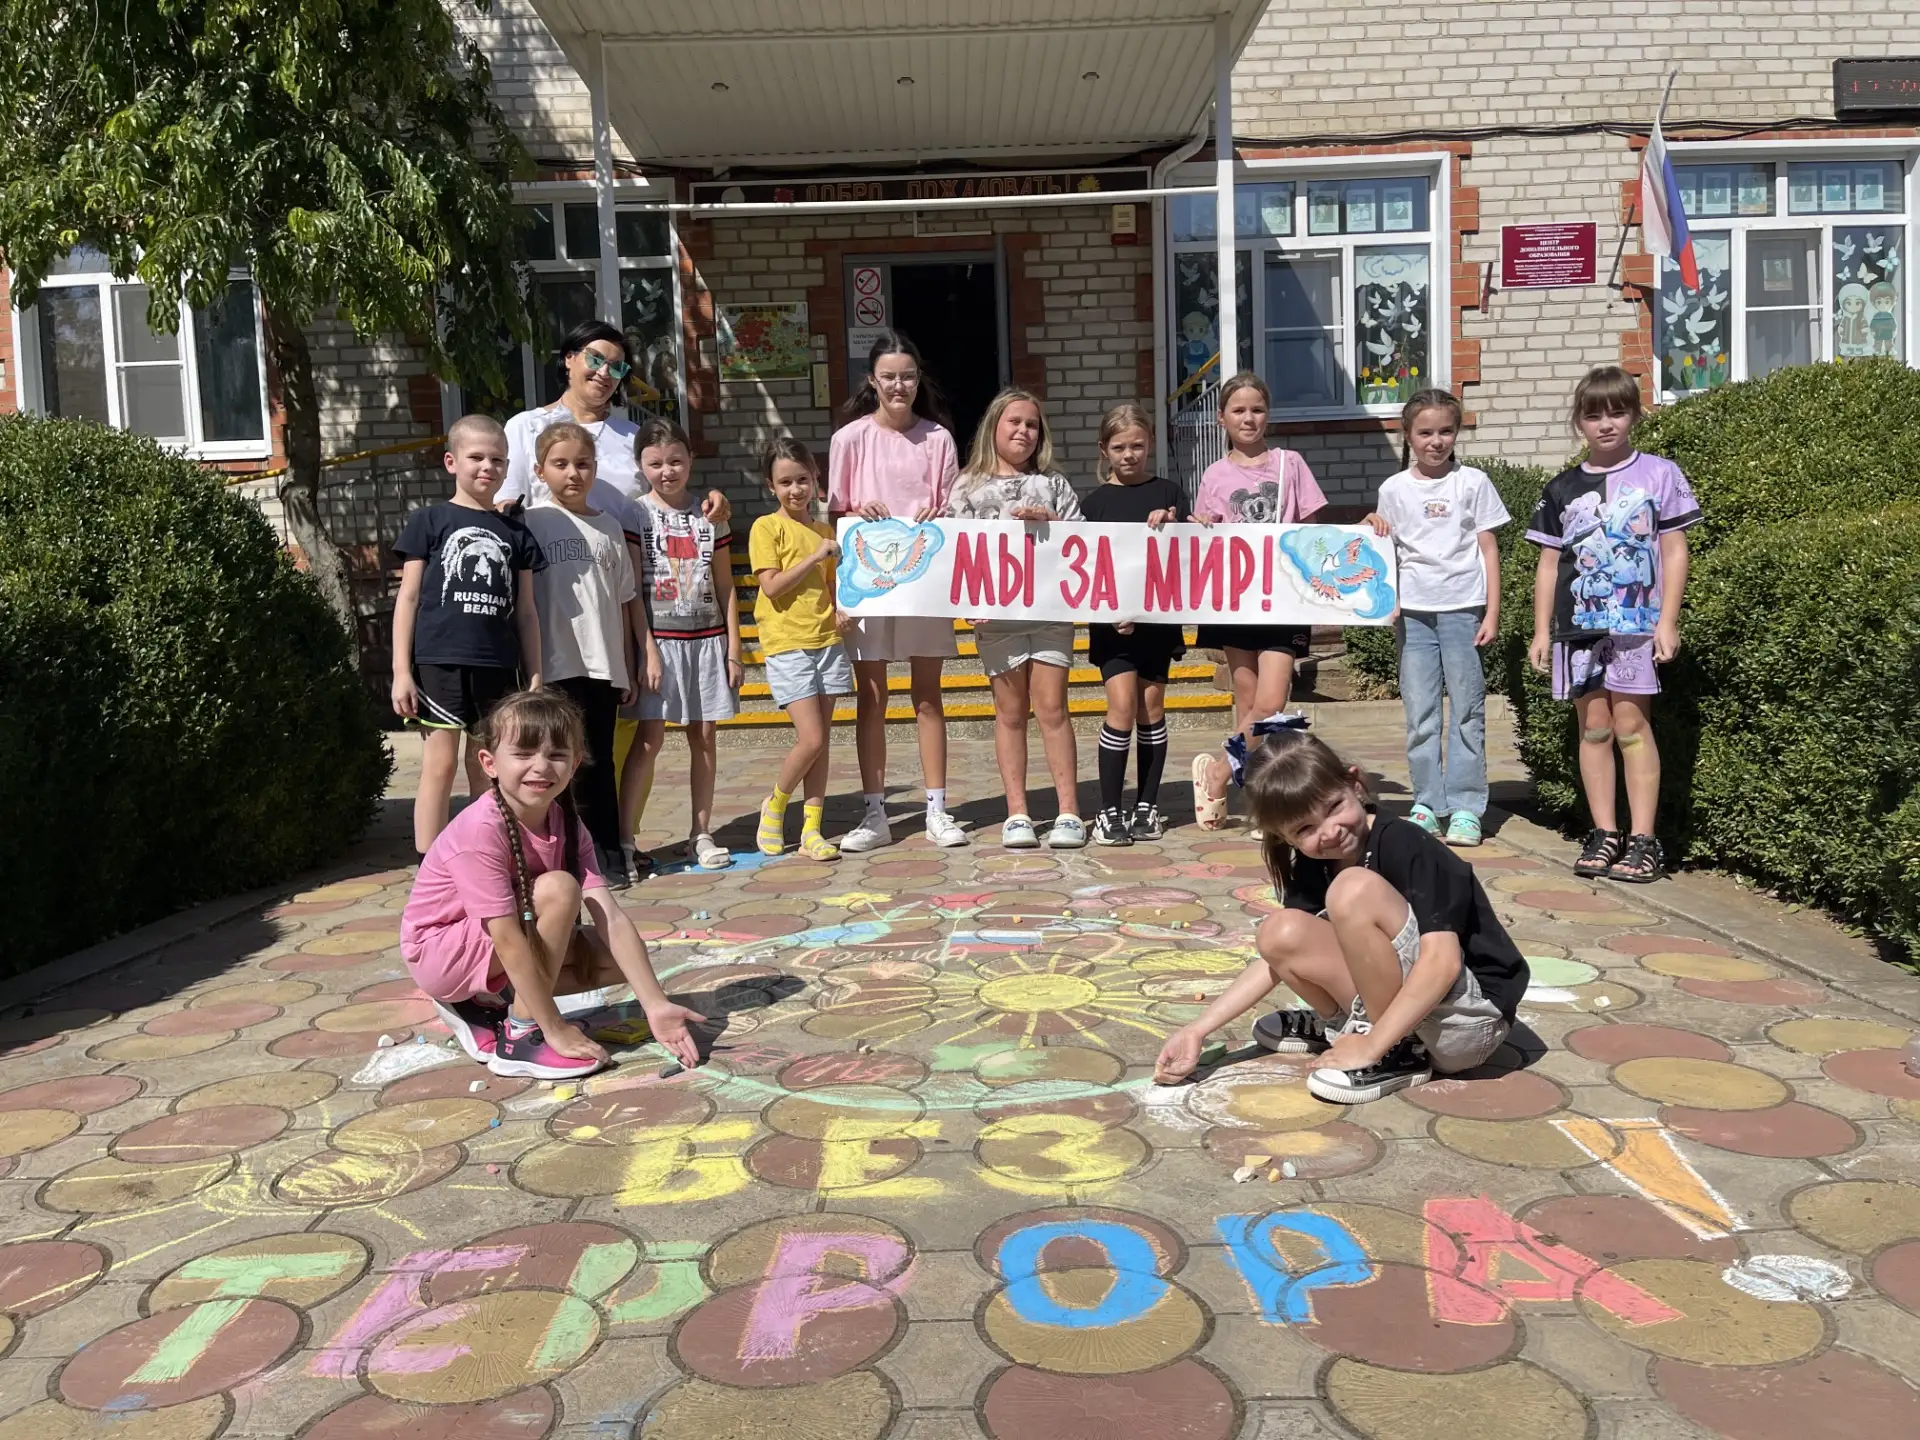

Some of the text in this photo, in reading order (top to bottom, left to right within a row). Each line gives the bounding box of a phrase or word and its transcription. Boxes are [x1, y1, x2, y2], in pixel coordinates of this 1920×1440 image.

[643, 526, 658, 567] INSPIRE
[949, 531, 1274, 612] МЫ ЗА МИР!
[453, 591, 508, 608] RUSSIAN
[463, 603, 498, 616] BEAR
[612, 1113, 1133, 1206] БЕЗ
